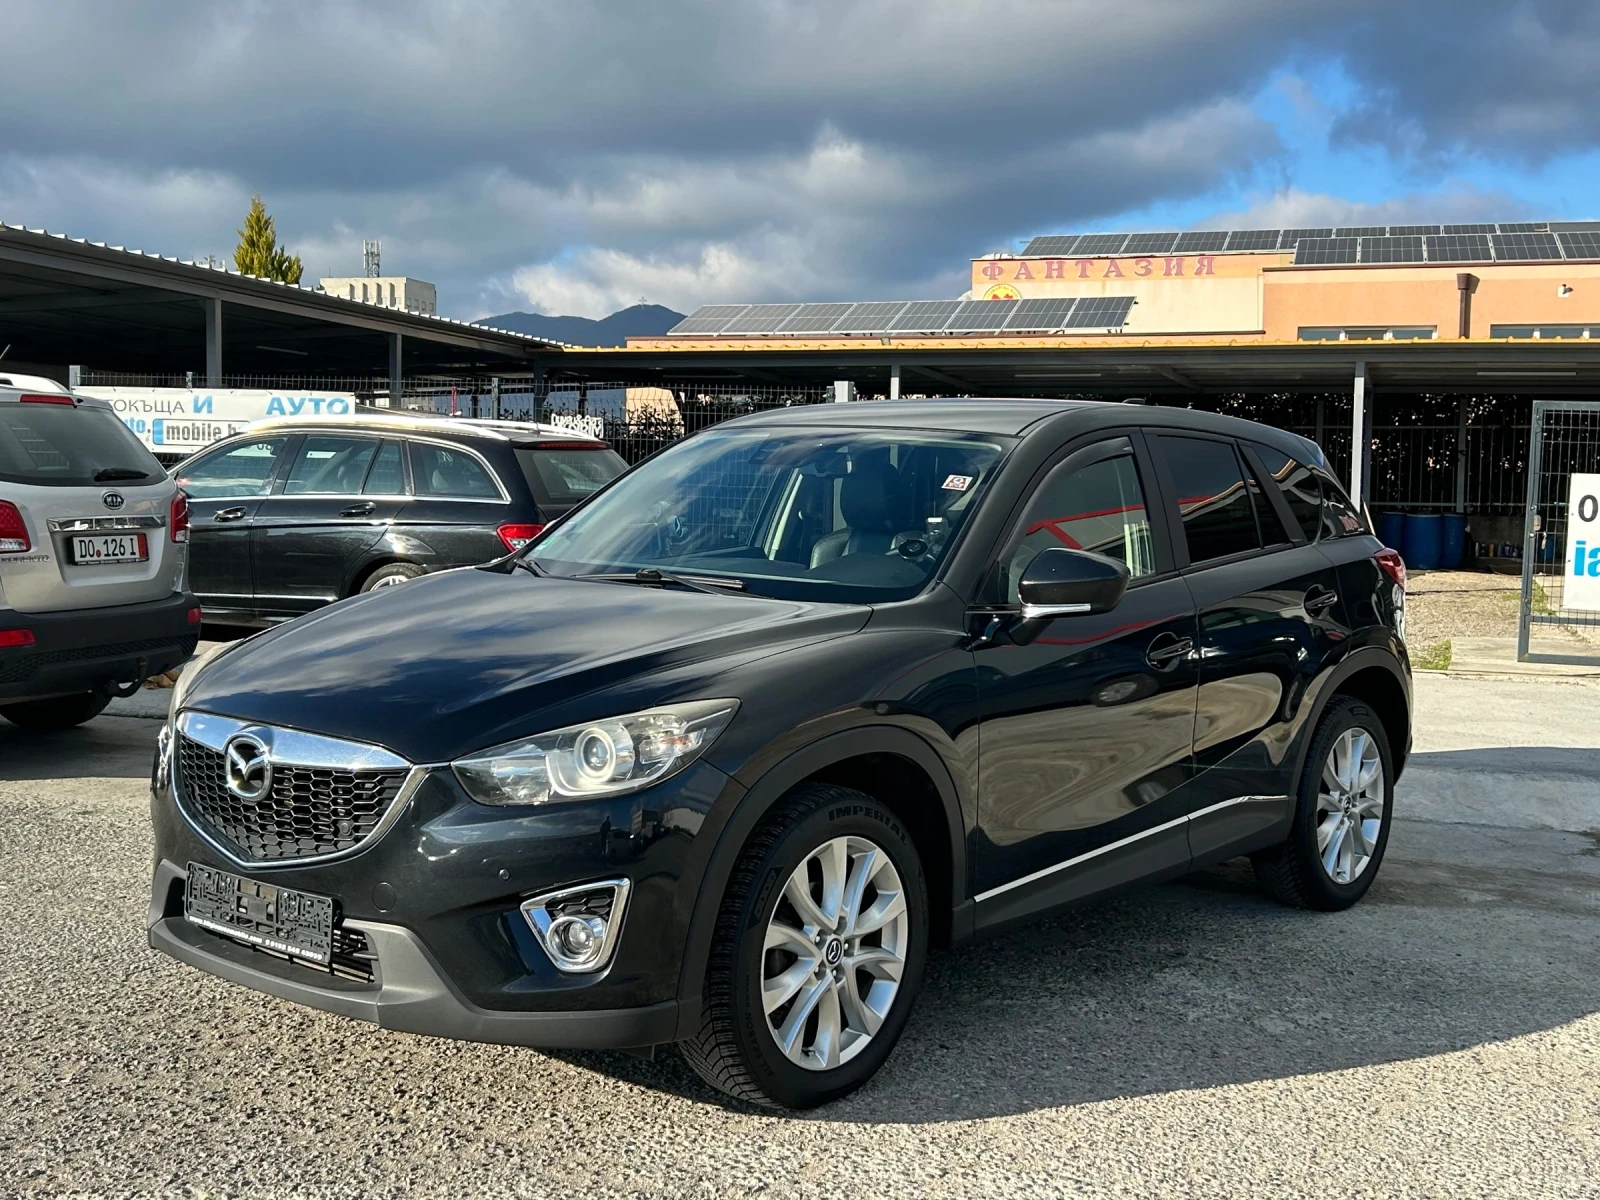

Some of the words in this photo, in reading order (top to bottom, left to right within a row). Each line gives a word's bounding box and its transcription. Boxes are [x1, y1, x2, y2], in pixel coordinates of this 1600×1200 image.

[982, 256, 1215, 280] ФАНТАЗИЯ
[193, 395, 213, 414] И
[266, 397, 349, 416] АУТО
[106, 494, 122, 506] KIA
[828, 805, 906, 846] IMPERIAL
